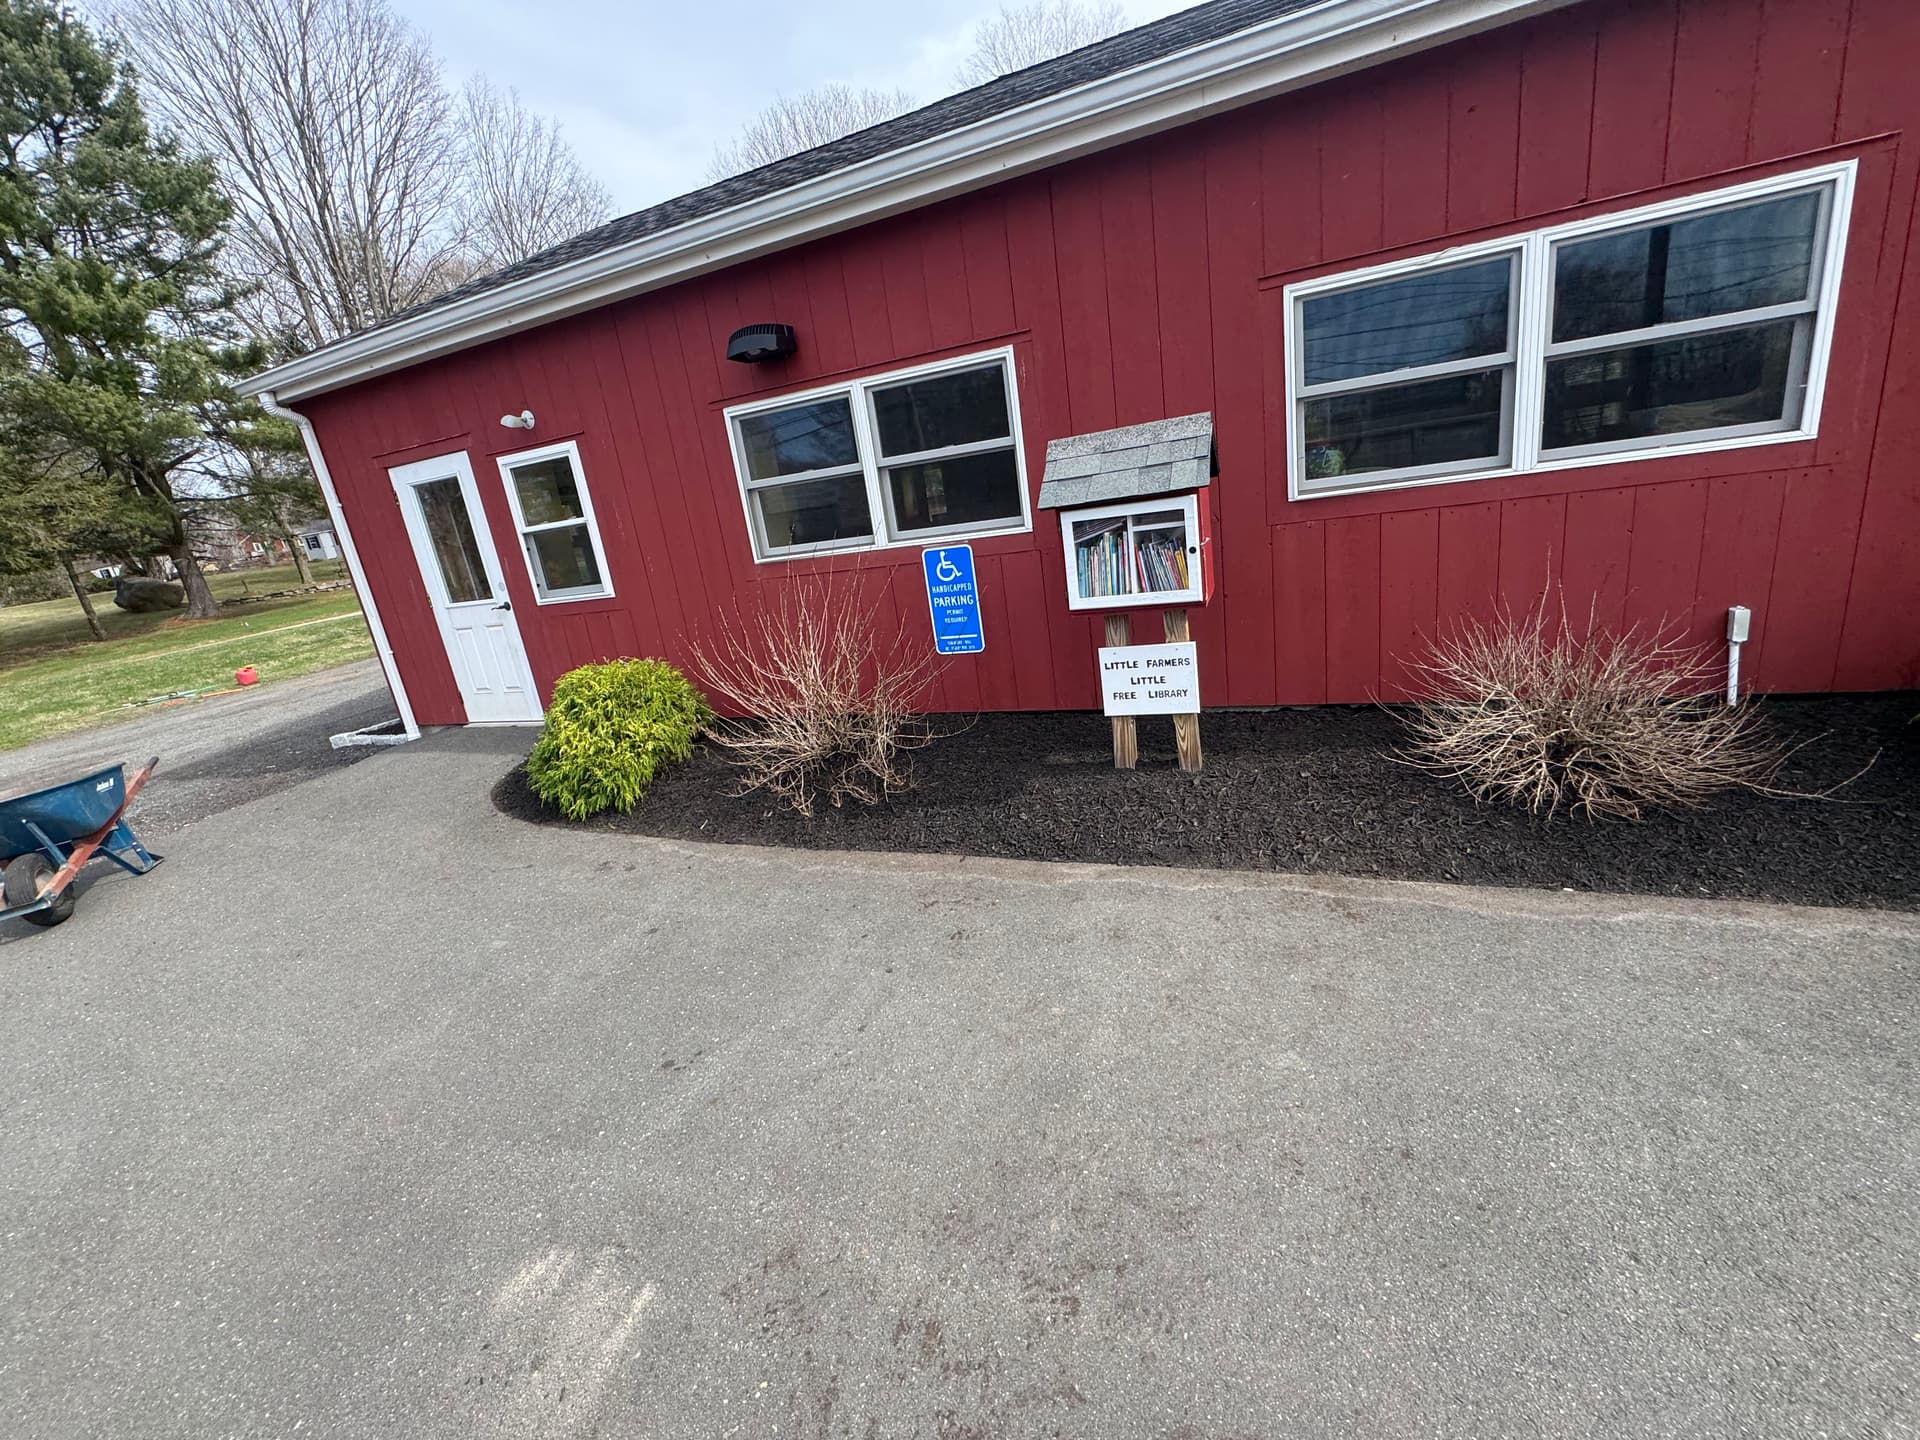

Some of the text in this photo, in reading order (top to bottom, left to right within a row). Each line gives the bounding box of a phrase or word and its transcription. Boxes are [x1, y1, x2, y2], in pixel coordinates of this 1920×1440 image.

[931, 582, 972, 593] HANDICAPPED
[933, 594, 974, 608] PARKING
[1104, 657, 1191, 670] LITTLE FARMERS
[1130, 675, 1167, 685] LITTLE
[1113, 688, 1188, 700] FREE LIBRARY
